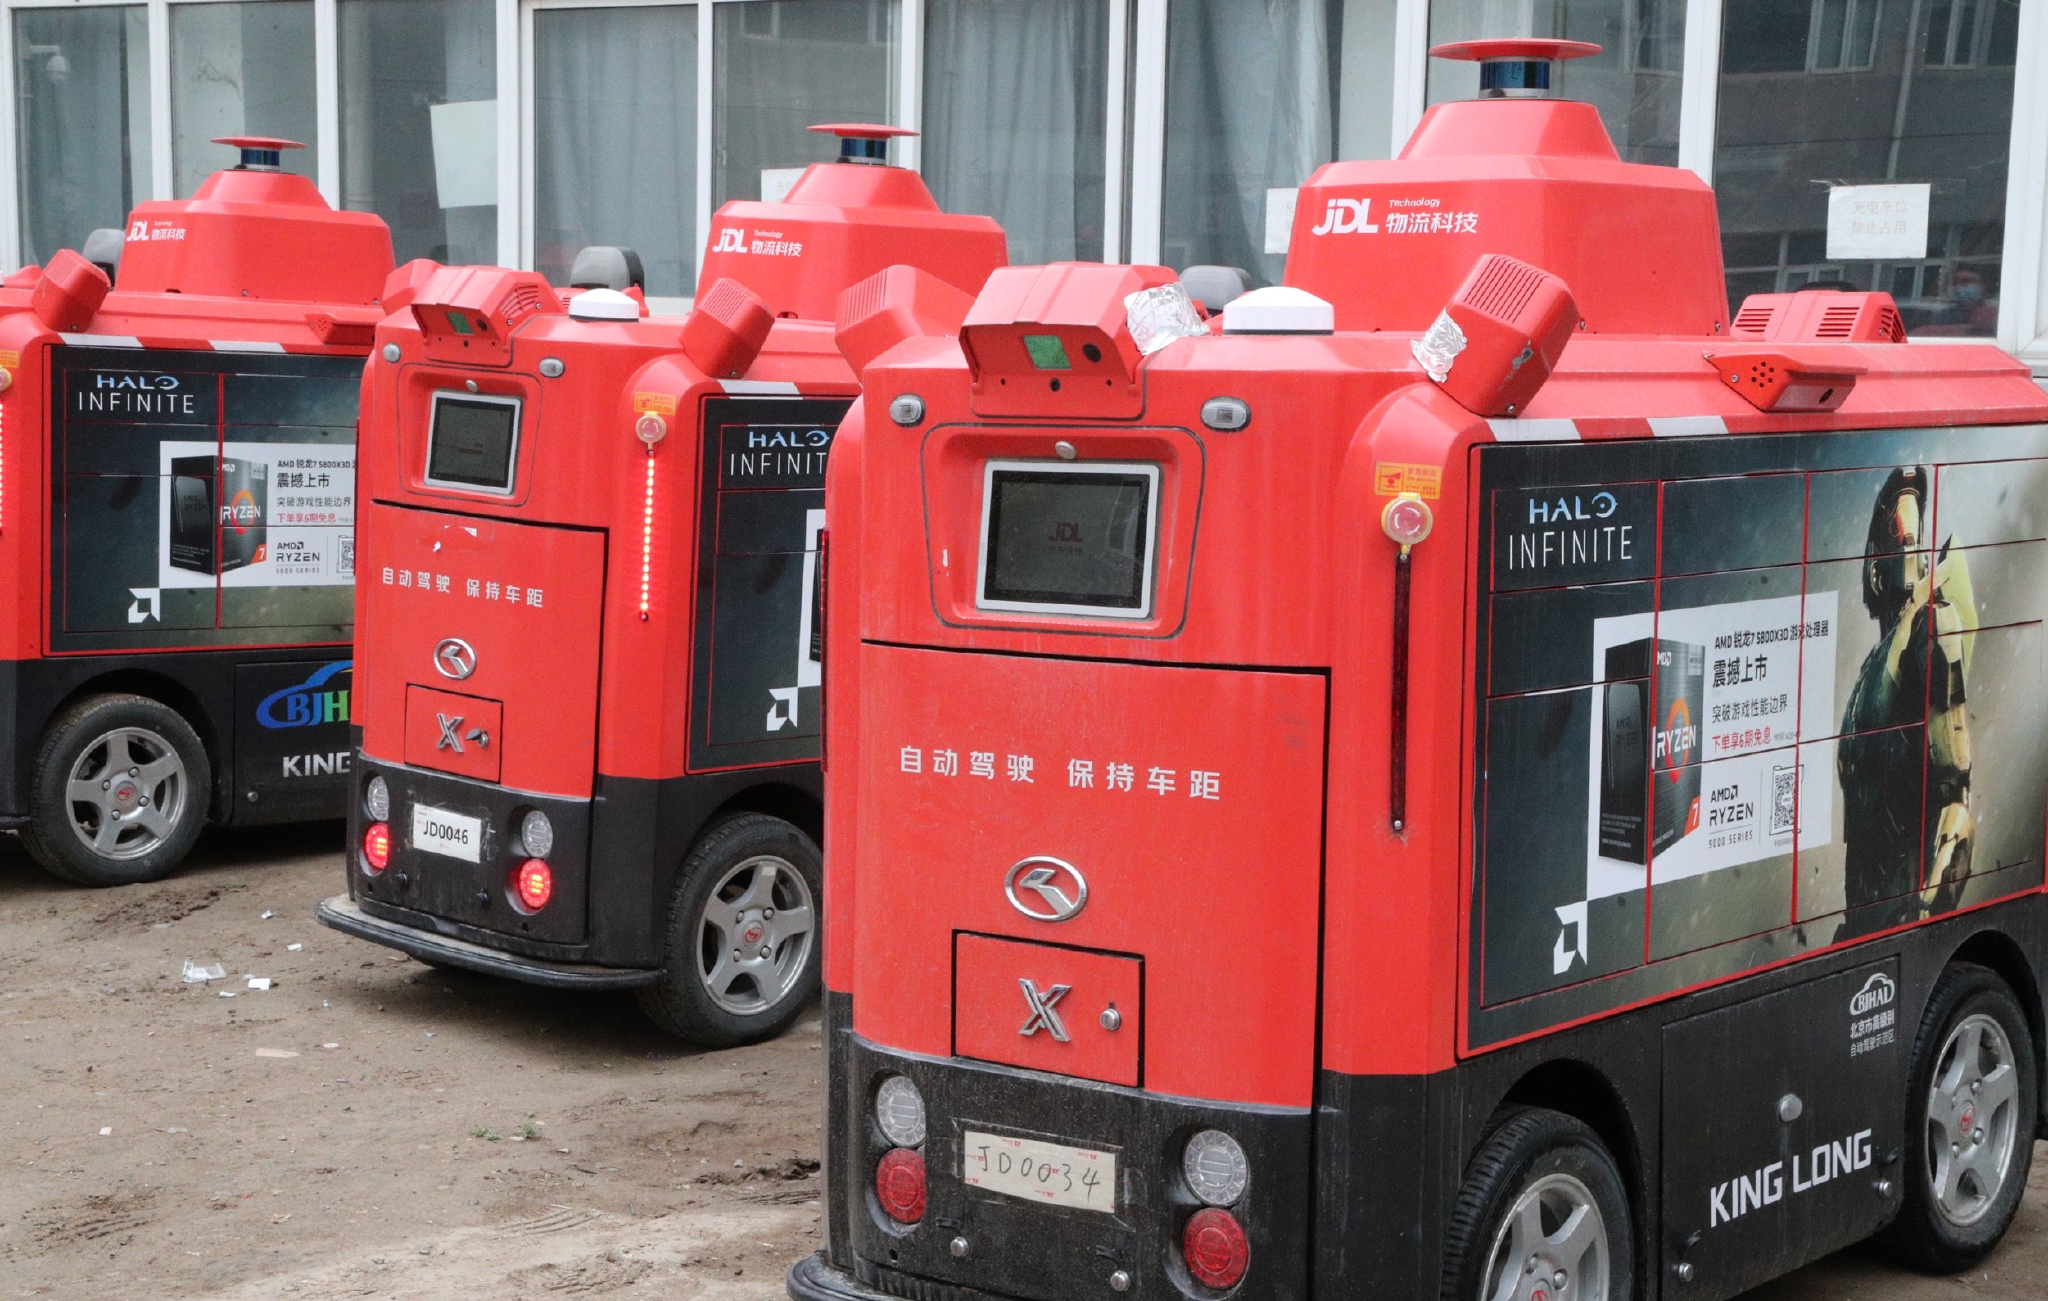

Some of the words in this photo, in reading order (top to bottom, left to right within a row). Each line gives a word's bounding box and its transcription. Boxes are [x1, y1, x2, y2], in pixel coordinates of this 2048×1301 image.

[1389, 197, 1440, 208] Technology
[1852, 200, 1908, 214] 充电车位
[1311, 198, 1379, 236] JDL
[1385, 212, 1479, 234] 物流科技
[1851, 220, 1907, 235] 禁止占用
[126, 221, 149, 241] JDL
[712, 228, 748, 253] JDL
[751, 240, 802, 257] 物流科技
[97, 374, 179, 390] HALO
[79, 391, 194, 414] INFINITE
[749, 430, 830, 448] HALO
[278, 460, 294, 468] AMD
[318, 460, 351, 469] 5800X3D
[276, 472, 330, 488] 震撼上市
[222, 505, 261, 520] RYZEN
[277, 496, 351, 508] 突破游戏性能边界
[1529, 492, 1618, 525] HALO
[277, 512, 336, 523] 下单享6期免息
[1049, 522, 1083, 543] JDL
[277, 541, 297, 550] AMD
[1510, 526, 1632, 570] INFINITE
[276, 552, 320, 562] RYZEN
[382, 566, 450, 593] 自动驾驶
[466, 578, 544, 608] 保持车距
[1714, 636, 1732, 650] AMD
[1756, 628, 1788, 645] 5800X3D
[1712, 653, 1768, 688] 震撼上市
[1712, 693, 1788, 723] 突破游戏性能边界
[1657, 725, 1697, 758] RYZEN
[1711, 725, 1771, 753] 下单享6期免息
[900, 745, 1034, 784] 自动驾驶
[1067, 758, 1221, 801] 保持车距
[1710, 787, 1731, 803] AMD
[1692, 802, 1699, 826] 7
[1709, 802, 1754, 827] RYZEN
[423, 820, 468, 845] JD0046
[1708, 836, 1725, 849] 5000
[1728, 830, 1753, 845] SERIES
[1850, 1009, 1895, 1040] 北京市高级别
[1850, 1028, 1895, 1058] 自动驾驶示范区
[978, 1145, 1101, 1204] JD0034
[1710, 1160, 1783, 1228] KING
[1792, 1128, 1872, 1193] LONG
